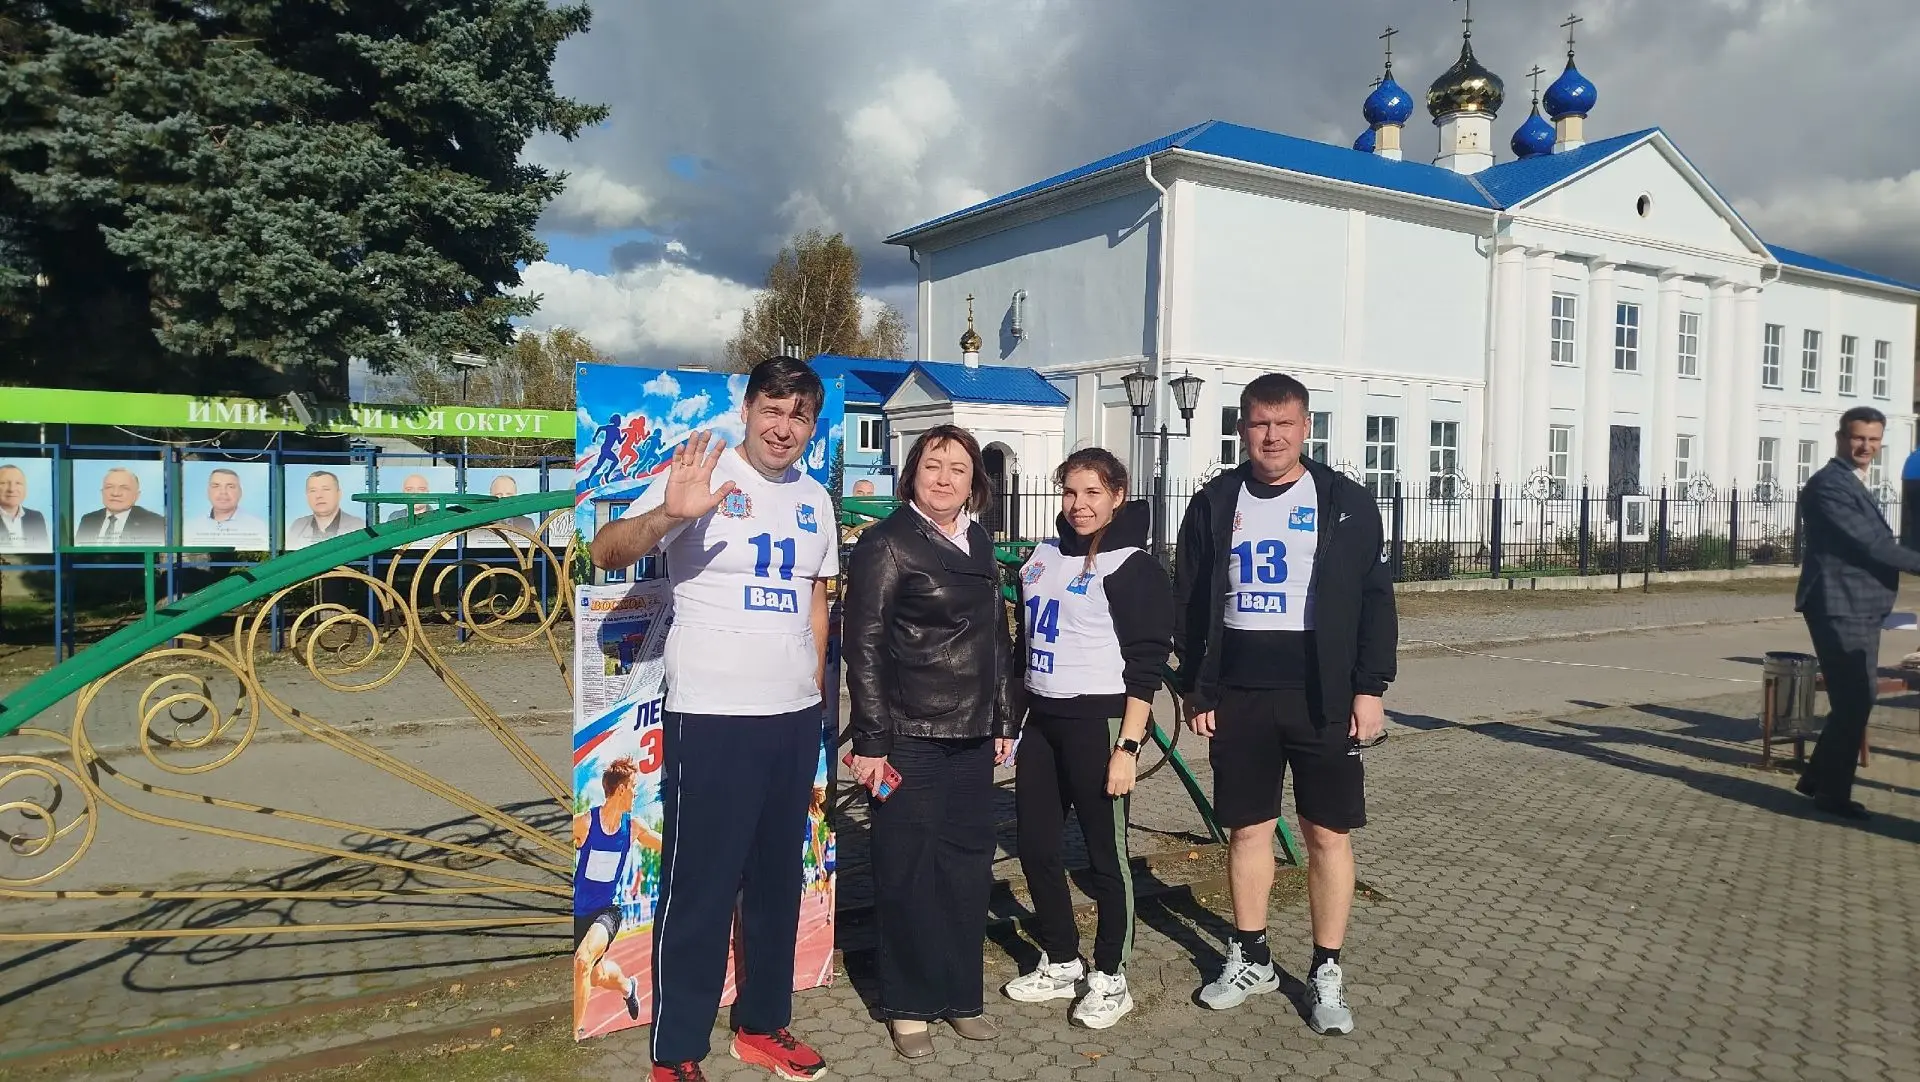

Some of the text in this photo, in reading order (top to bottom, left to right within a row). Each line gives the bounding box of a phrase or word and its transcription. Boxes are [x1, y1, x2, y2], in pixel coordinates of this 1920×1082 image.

[188, 400, 268, 425] ИМИ
[455, 411, 550, 433] ОКРУГ
[748, 533, 796, 580] 11
[1231, 539, 1288, 584] 13
[750, 587, 794, 612] Вад
[1240, 592, 1282, 613] Вад
[1026, 595, 1060, 643] 14
[1031, 652, 1049, 672] ад
[634, 698, 661, 731] ЛЕ
